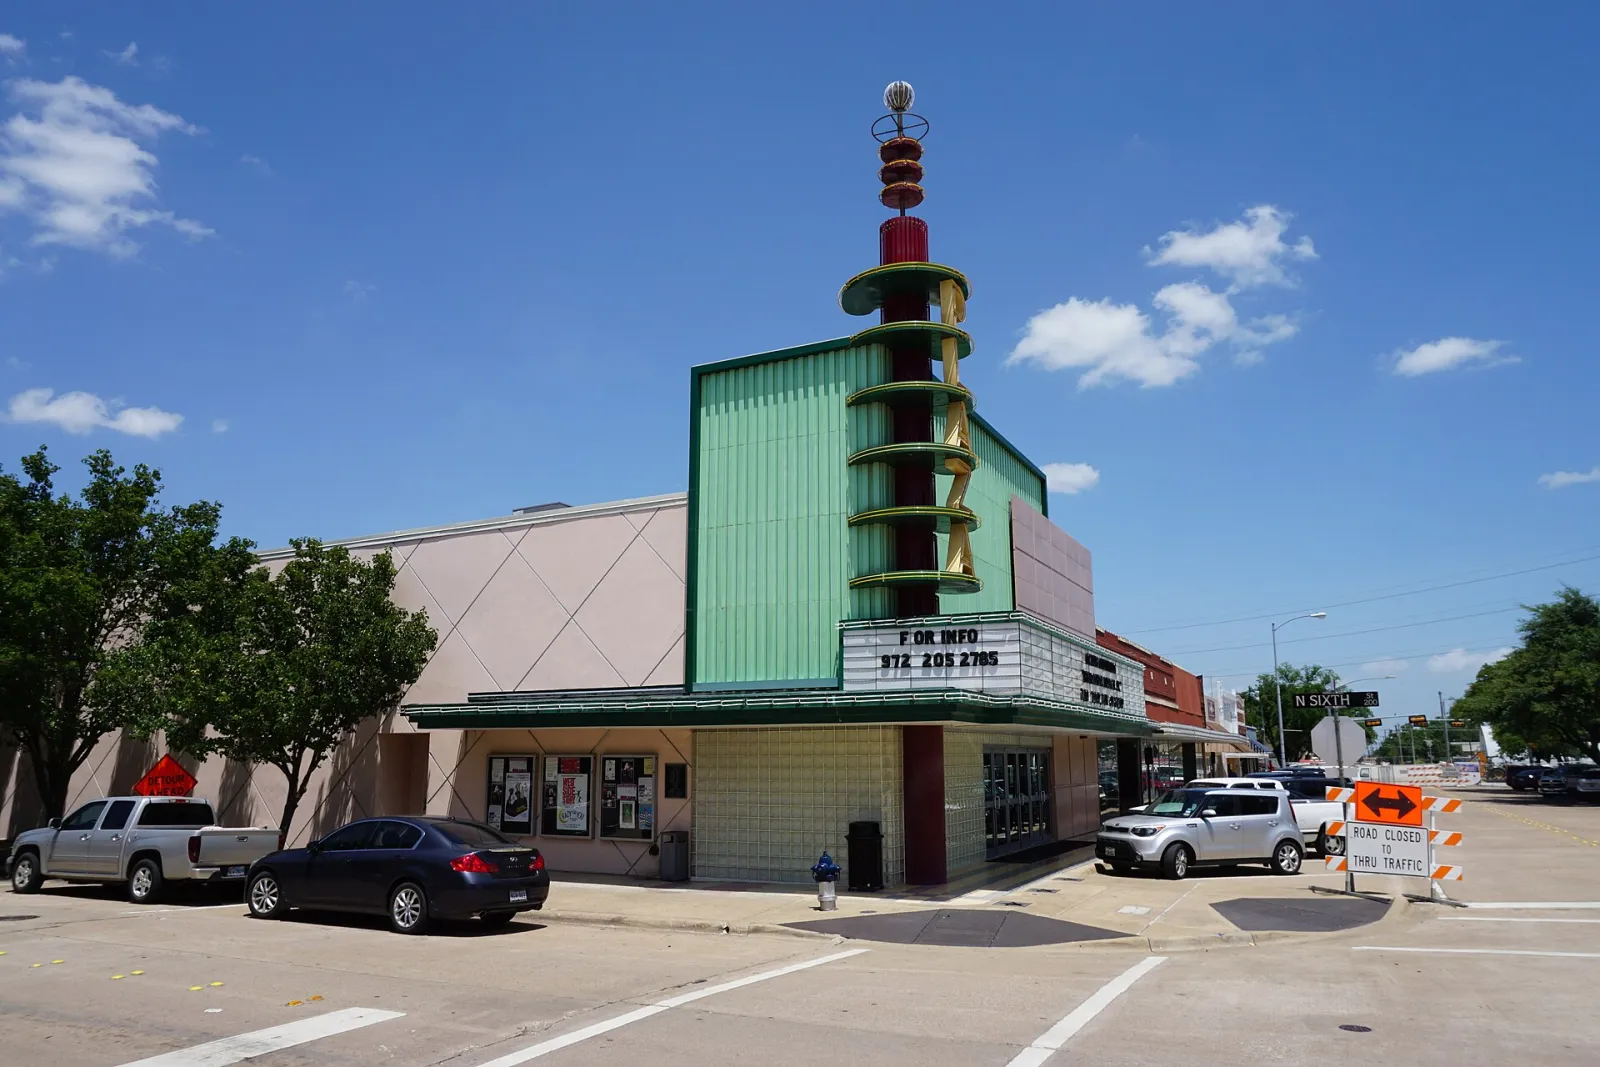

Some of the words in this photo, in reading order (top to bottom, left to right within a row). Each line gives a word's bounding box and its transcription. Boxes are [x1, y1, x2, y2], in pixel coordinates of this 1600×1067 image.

[941, 629, 979, 645] INFO
[881, 654, 911, 668] 972
[922, 652, 955, 668] 205
[960, 650, 999, 667] 2785
[1295, 695, 1306, 707] N
[1309, 694, 1351, 707] SIXTH
[147, 775, 185, 786] DETOUR
[150, 786, 184, 796] AHEAD
[1353, 826, 1378, 839] ROAD
[1385, 829, 1421, 843] CLOSED
[1382, 844, 1392, 854] TO
[1353, 855, 1377, 868] THRU
[1383, 857, 1423, 871] TRAFFIC
